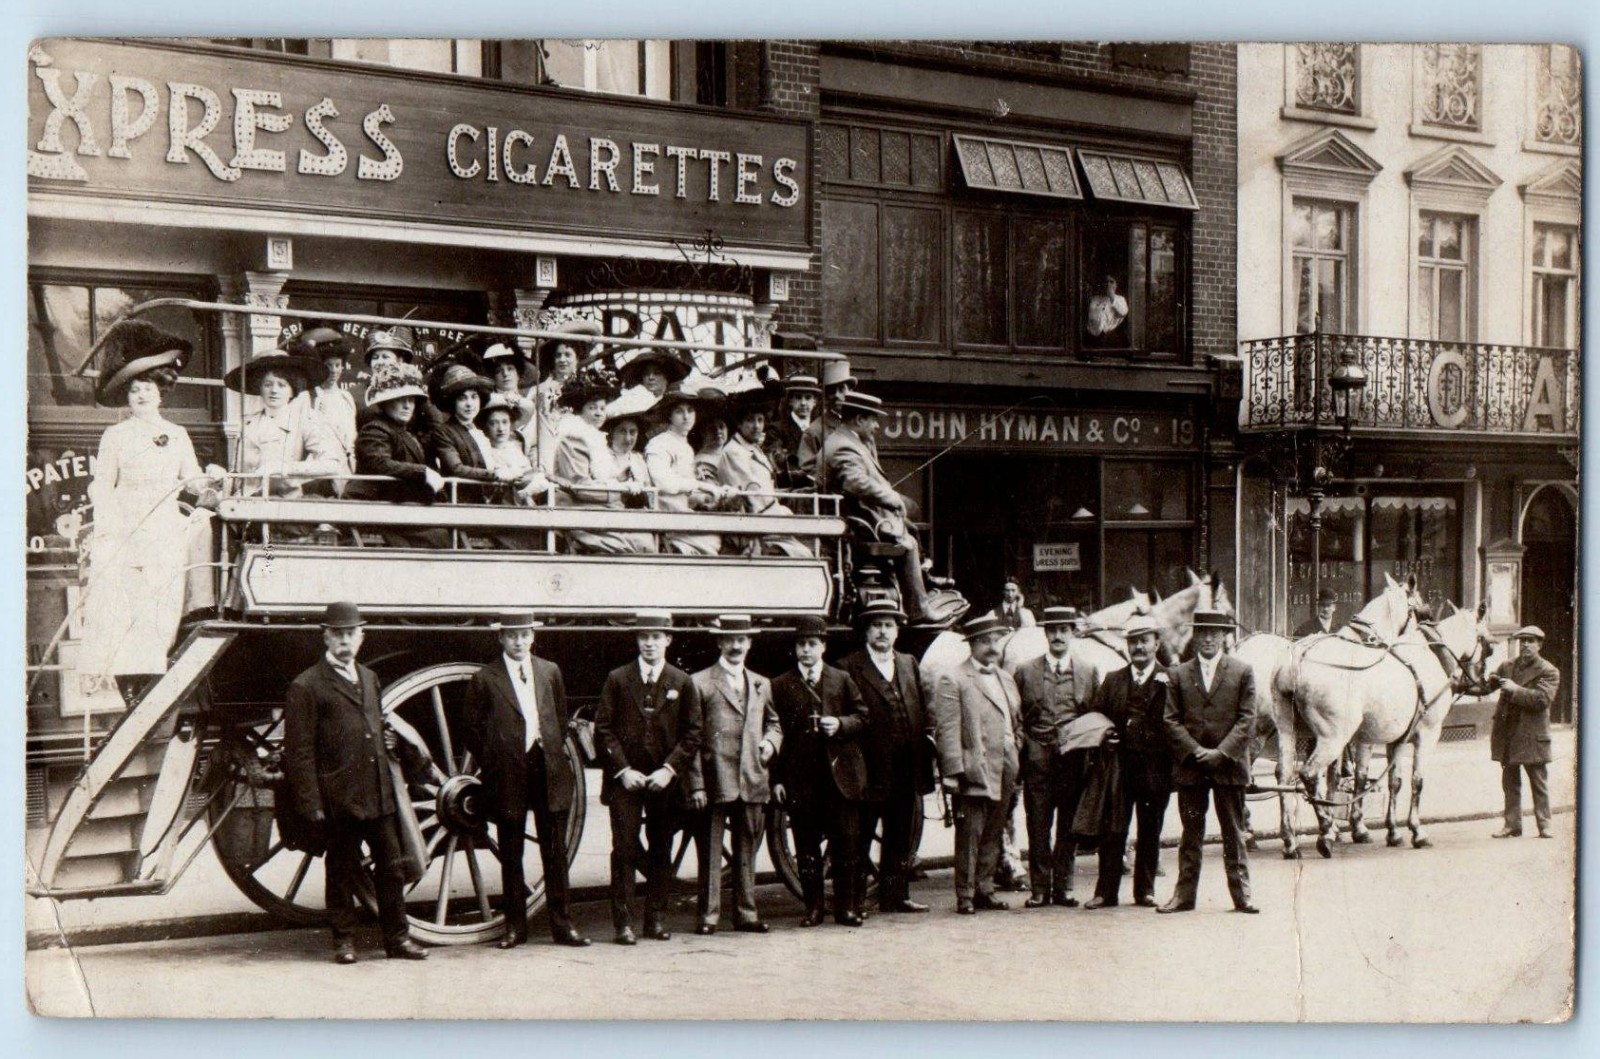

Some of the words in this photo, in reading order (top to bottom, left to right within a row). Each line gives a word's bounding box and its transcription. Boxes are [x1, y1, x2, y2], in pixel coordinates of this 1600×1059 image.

[447, 123, 800, 207] CIGARETTES
[342, 322, 370, 340] BEE
[884, 411, 967, 440] JOHN
[980, 413, 1080, 442] HYMAN
[1086, 419, 1105, 442] &
[1039, 547, 1073, 556] EVENING
